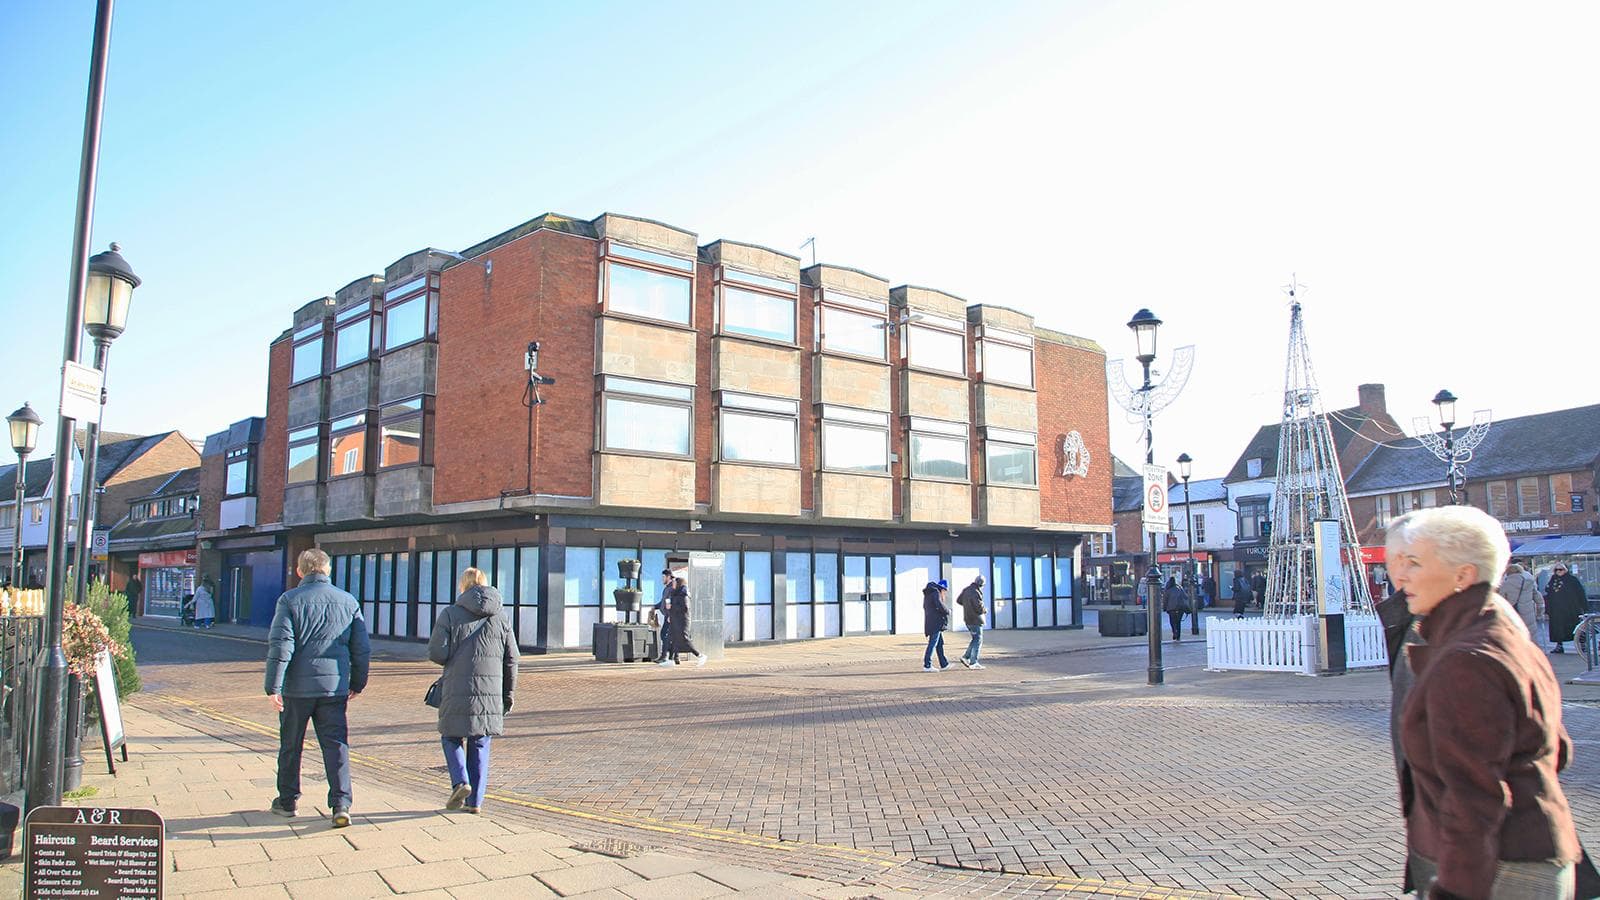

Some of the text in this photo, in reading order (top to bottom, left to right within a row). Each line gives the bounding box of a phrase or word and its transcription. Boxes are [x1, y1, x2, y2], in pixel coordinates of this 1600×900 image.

[1532, 520, 1550, 528] NAILS
[74, 808, 121, 824] A & R
[35, 834, 76, 845] Haircuts
[91, 836, 158, 847] Beard Services
